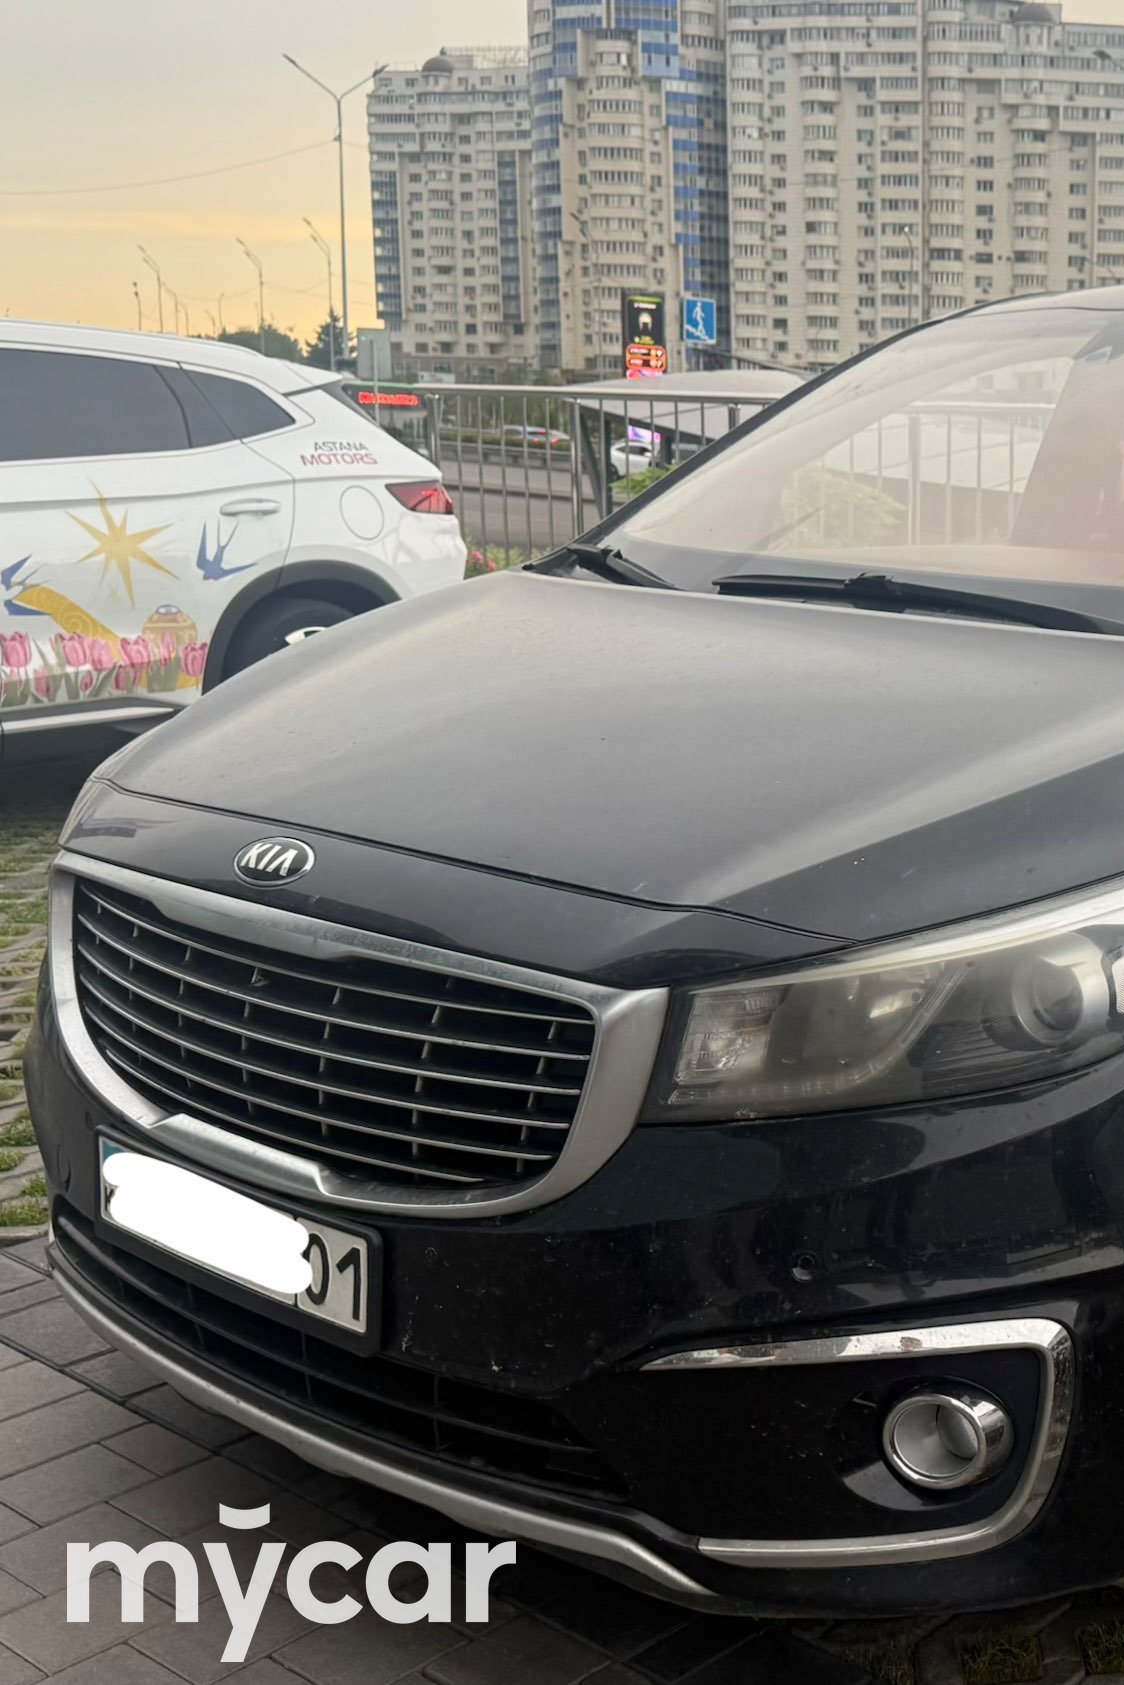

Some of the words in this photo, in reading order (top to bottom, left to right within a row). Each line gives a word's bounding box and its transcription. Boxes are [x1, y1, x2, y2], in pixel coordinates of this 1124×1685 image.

[314, 441, 369, 452] ASTANA
[300, 453, 378, 466] MOTORS
[240, 842, 298, 877] KIA
